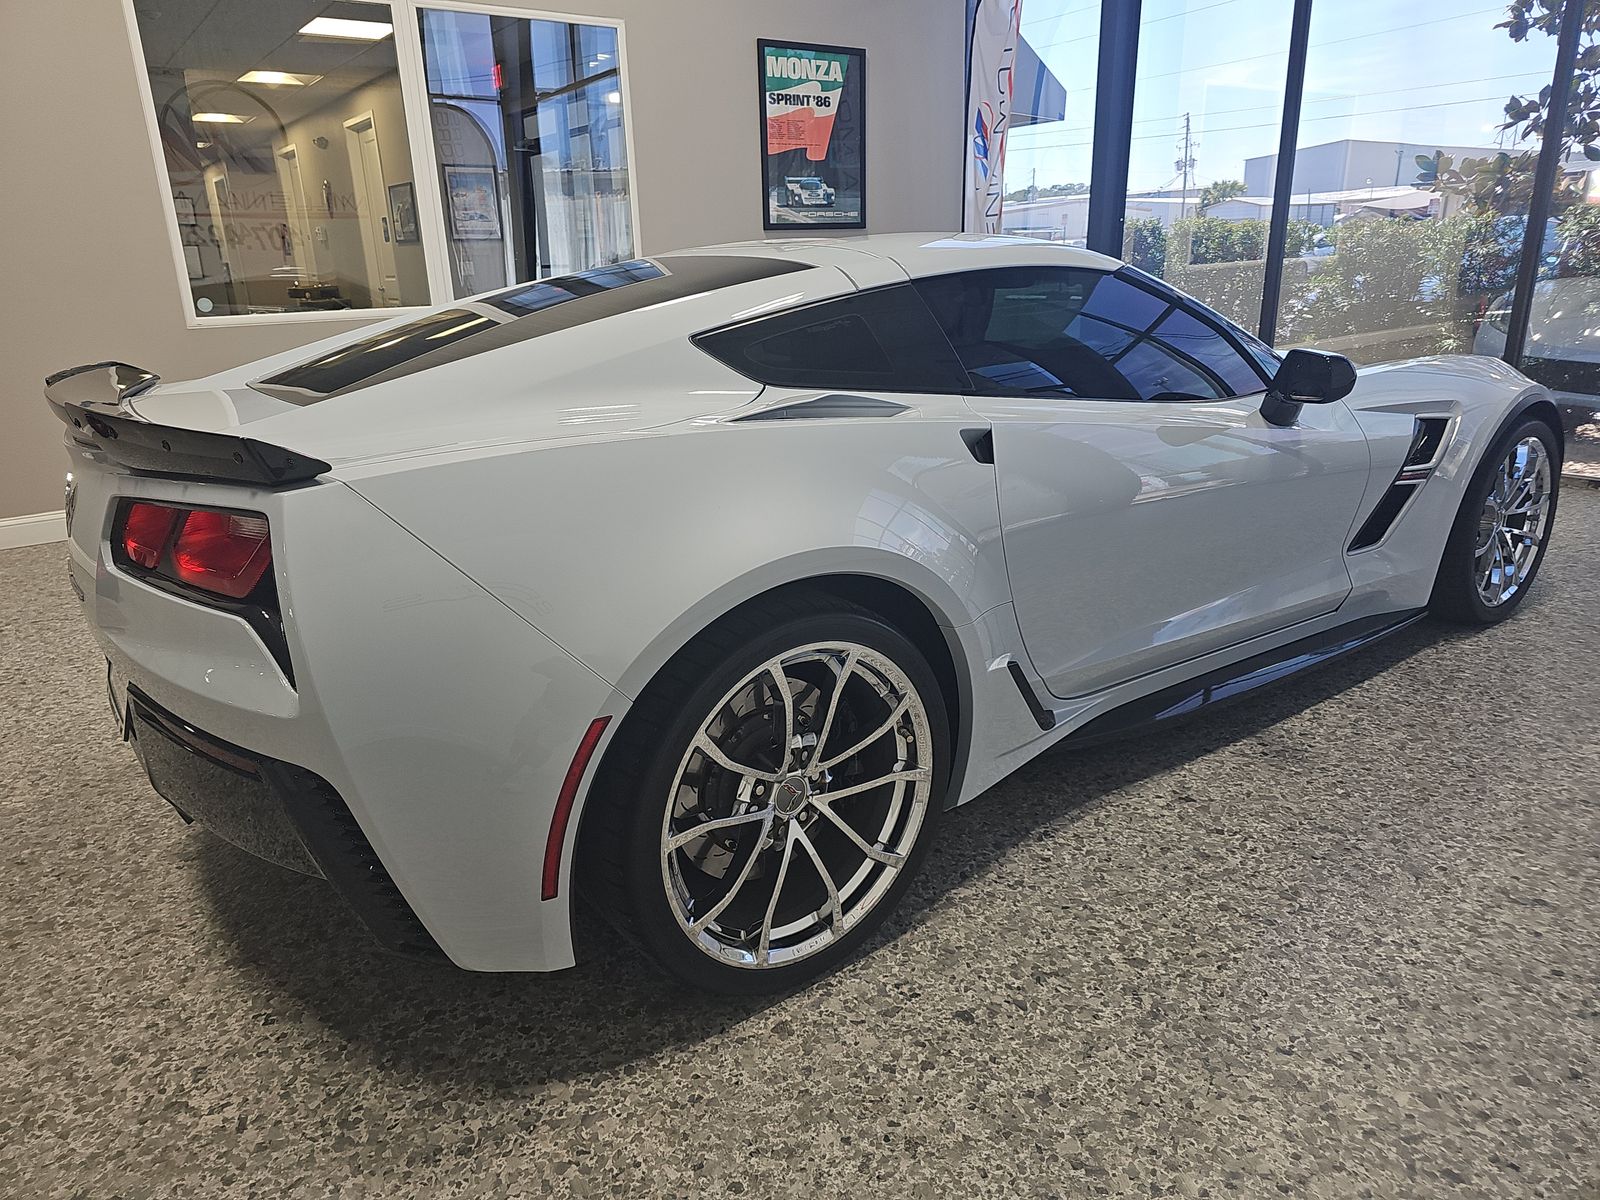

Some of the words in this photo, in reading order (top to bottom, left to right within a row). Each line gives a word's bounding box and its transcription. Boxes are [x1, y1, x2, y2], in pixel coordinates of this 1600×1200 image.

[766, 55, 843, 82] MONZA
[768, 92, 812, 107] SPRINT
[812, 95, 831, 108] '86
